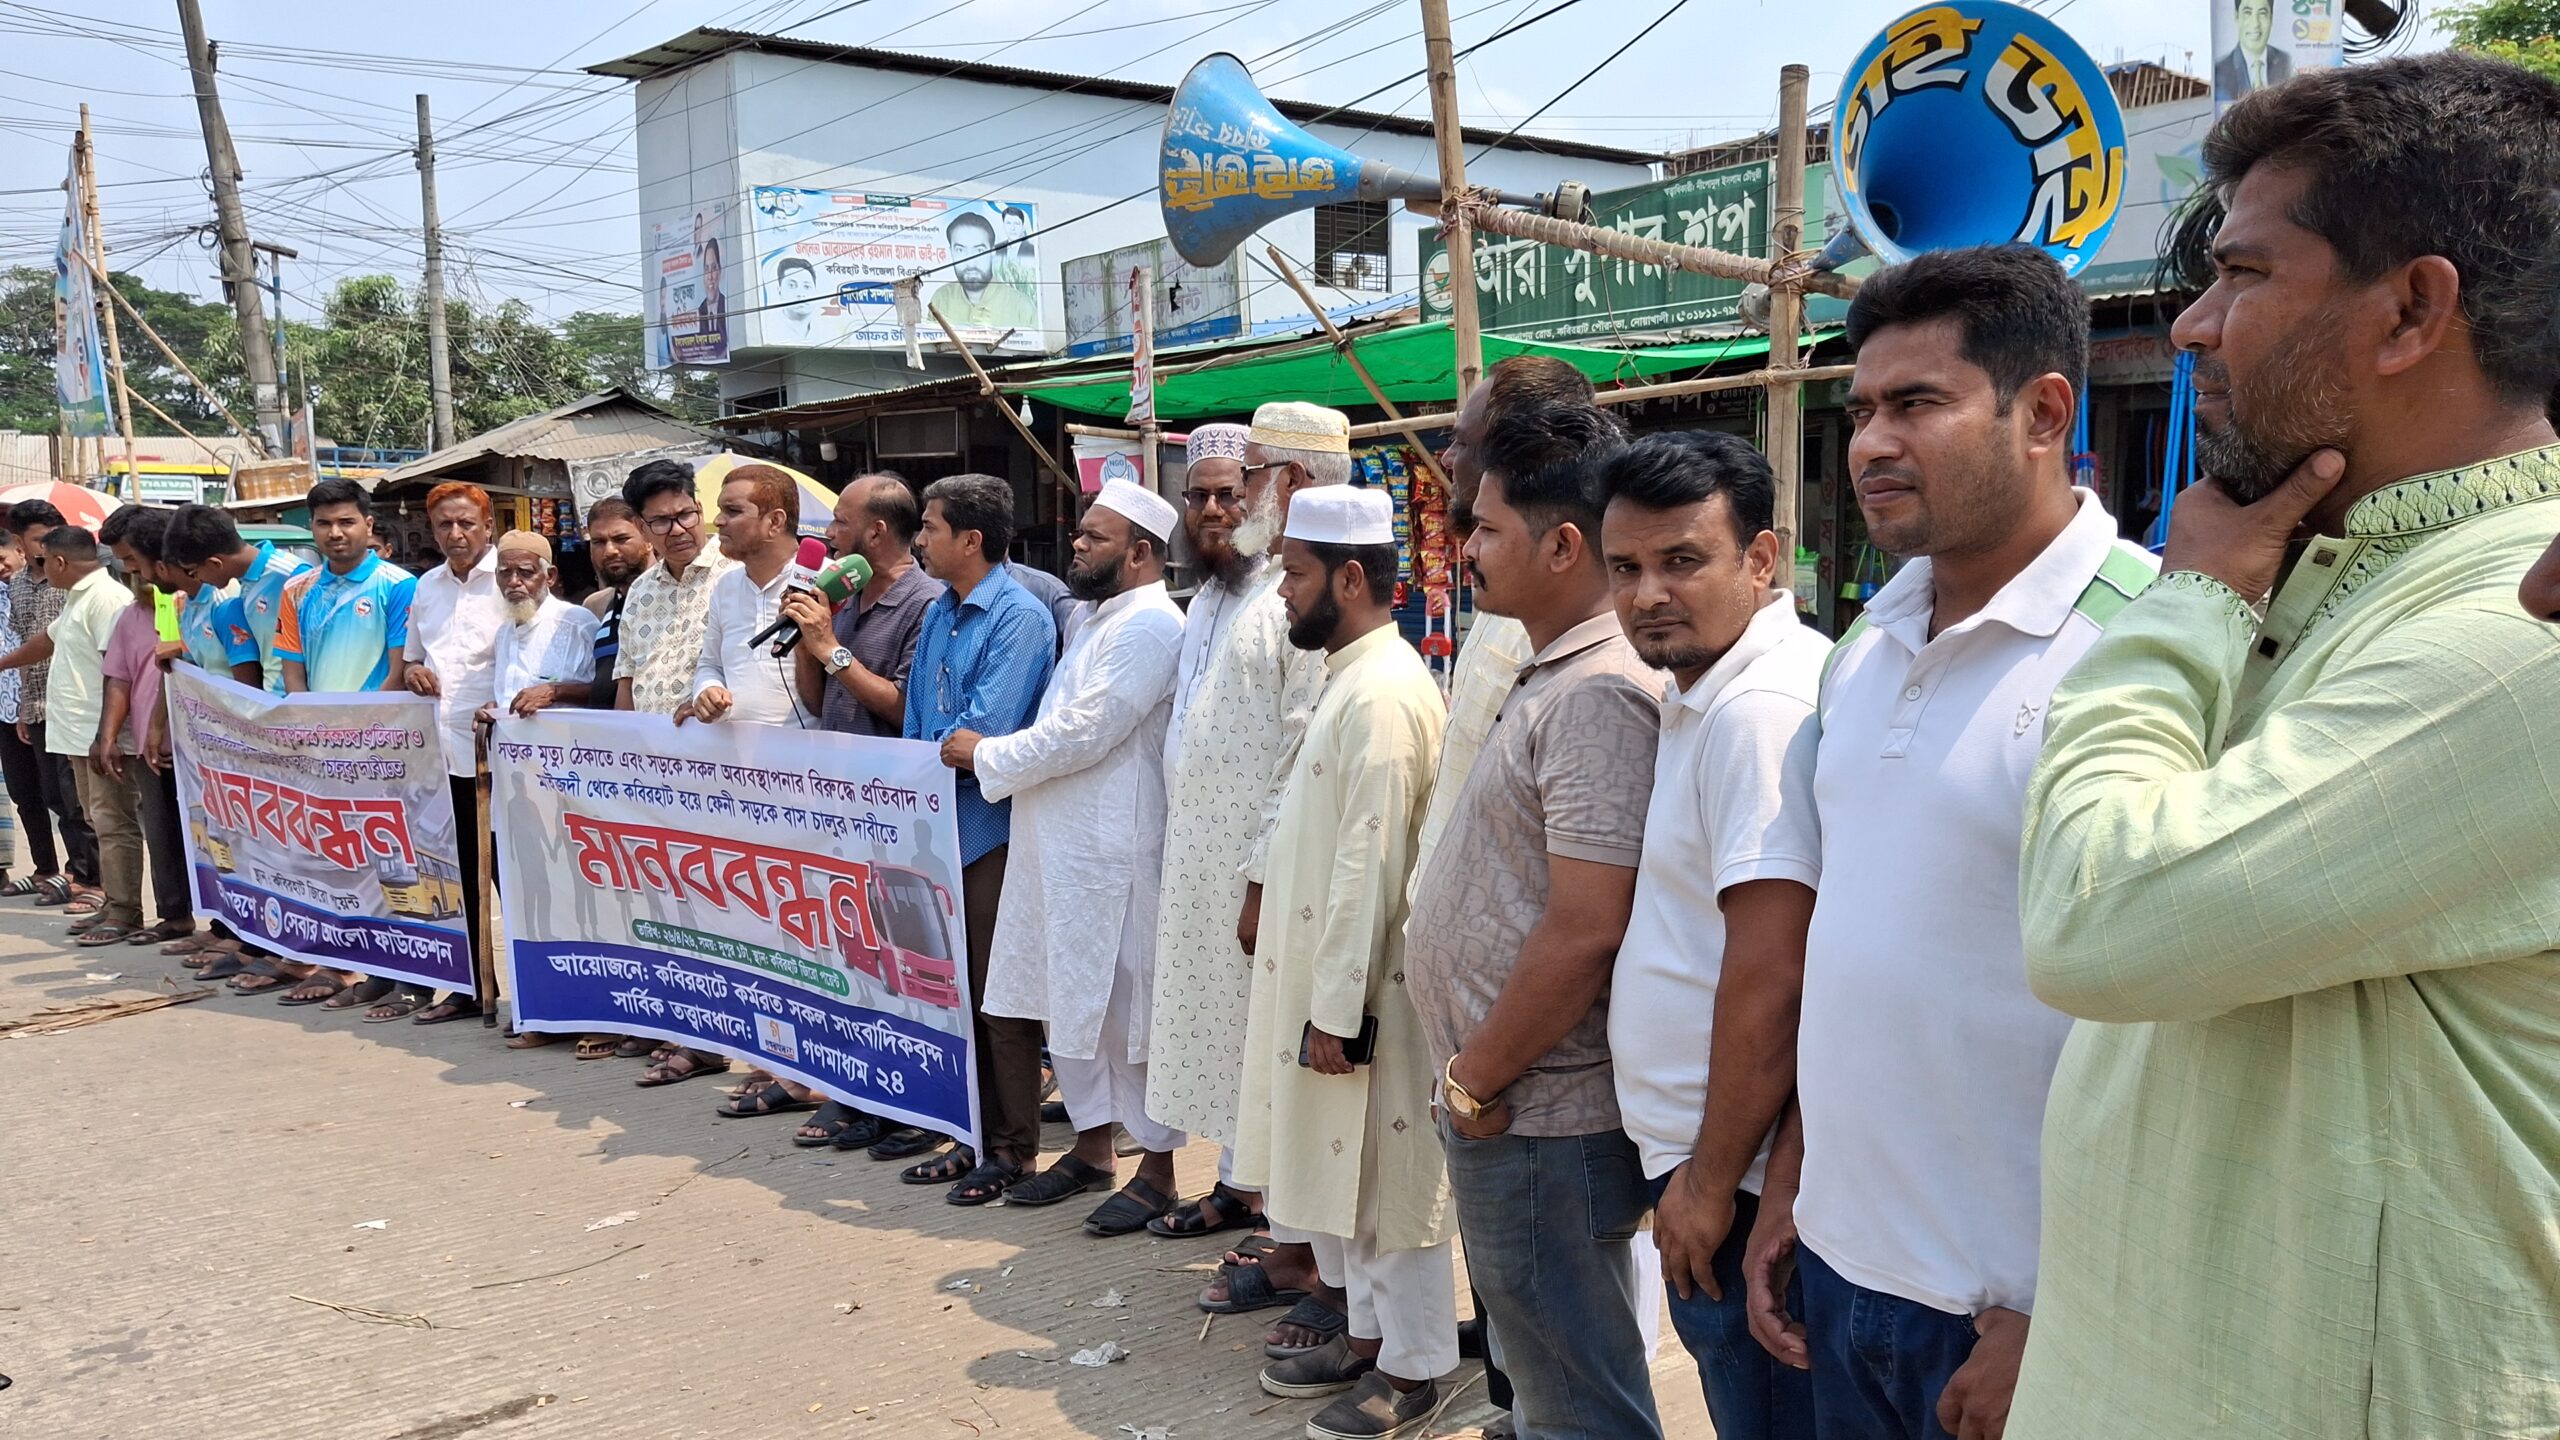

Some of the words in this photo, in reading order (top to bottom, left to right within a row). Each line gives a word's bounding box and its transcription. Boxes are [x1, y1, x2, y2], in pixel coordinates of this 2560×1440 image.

[825, 262, 860, 277] কবিরহাট
[861, 263, 895, 277] উপজেলা
[870, 288, 896, 303] সম্পাদ
[1474, 234, 1547, 305] আরা
[1557, 322, 1589, 337] কবিরহাট
[411, 728, 425, 748] ও
[498, 741, 533, 763] সড়কে
[538, 743, 565, 771] মৃত্যু
[570, 739, 614, 767] ঠেকাতে
[619, 751, 645, 774] এবং
[646, 754, 683, 777] সড়কে
[686, 758, 717, 782] সকল
[720, 764, 805, 795] অব্যবস্থাপনার
[808, 768, 856, 804] বিরুদ্ধে
[861, 777, 918, 813] প্রতিবাদ
[925, 793, 940, 814] ও
[196, 760, 418, 872] মানববন্ধন
[586, 779, 619, 800] থেকে
[624, 780, 674, 808] কবিরহাট
[676, 789, 702, 812] হয়ে
[706, 789, 736, 818] ফেনী
[738, 799, 778, 825] সড়কে
[781, 806, 808, 831] বাস
[810, 811, 848, 841] চালুর
[851, 812, 898, 845] দাবীতে
[562, 810, 881, 952] মানববন্ধন
[284, 911, 319, 943] সেবার
[321, 921, 369, 949] আলো
[371, 927, 453, 967] ফাউন্ডেশন
[769, 951, 799, 975] কবিরহাট
[799, 959, 819, 982] জিরো
[547, 952, 650, 983] আয়োজনে:
[652, 961, 728, 999] কবিরহাটে
[730, 980, 784, 1016] কর্মরত
[788, 998, 829, 1033] সকল
[831, 1018, 945, 1076] সাংবাদিকবৃন্দ
[609, 987, 665, 1018] সার্বিক
[802, 1036, 869, 1088] গণমাধ্যম
[875, 1066, 906, 1097] ২৪
